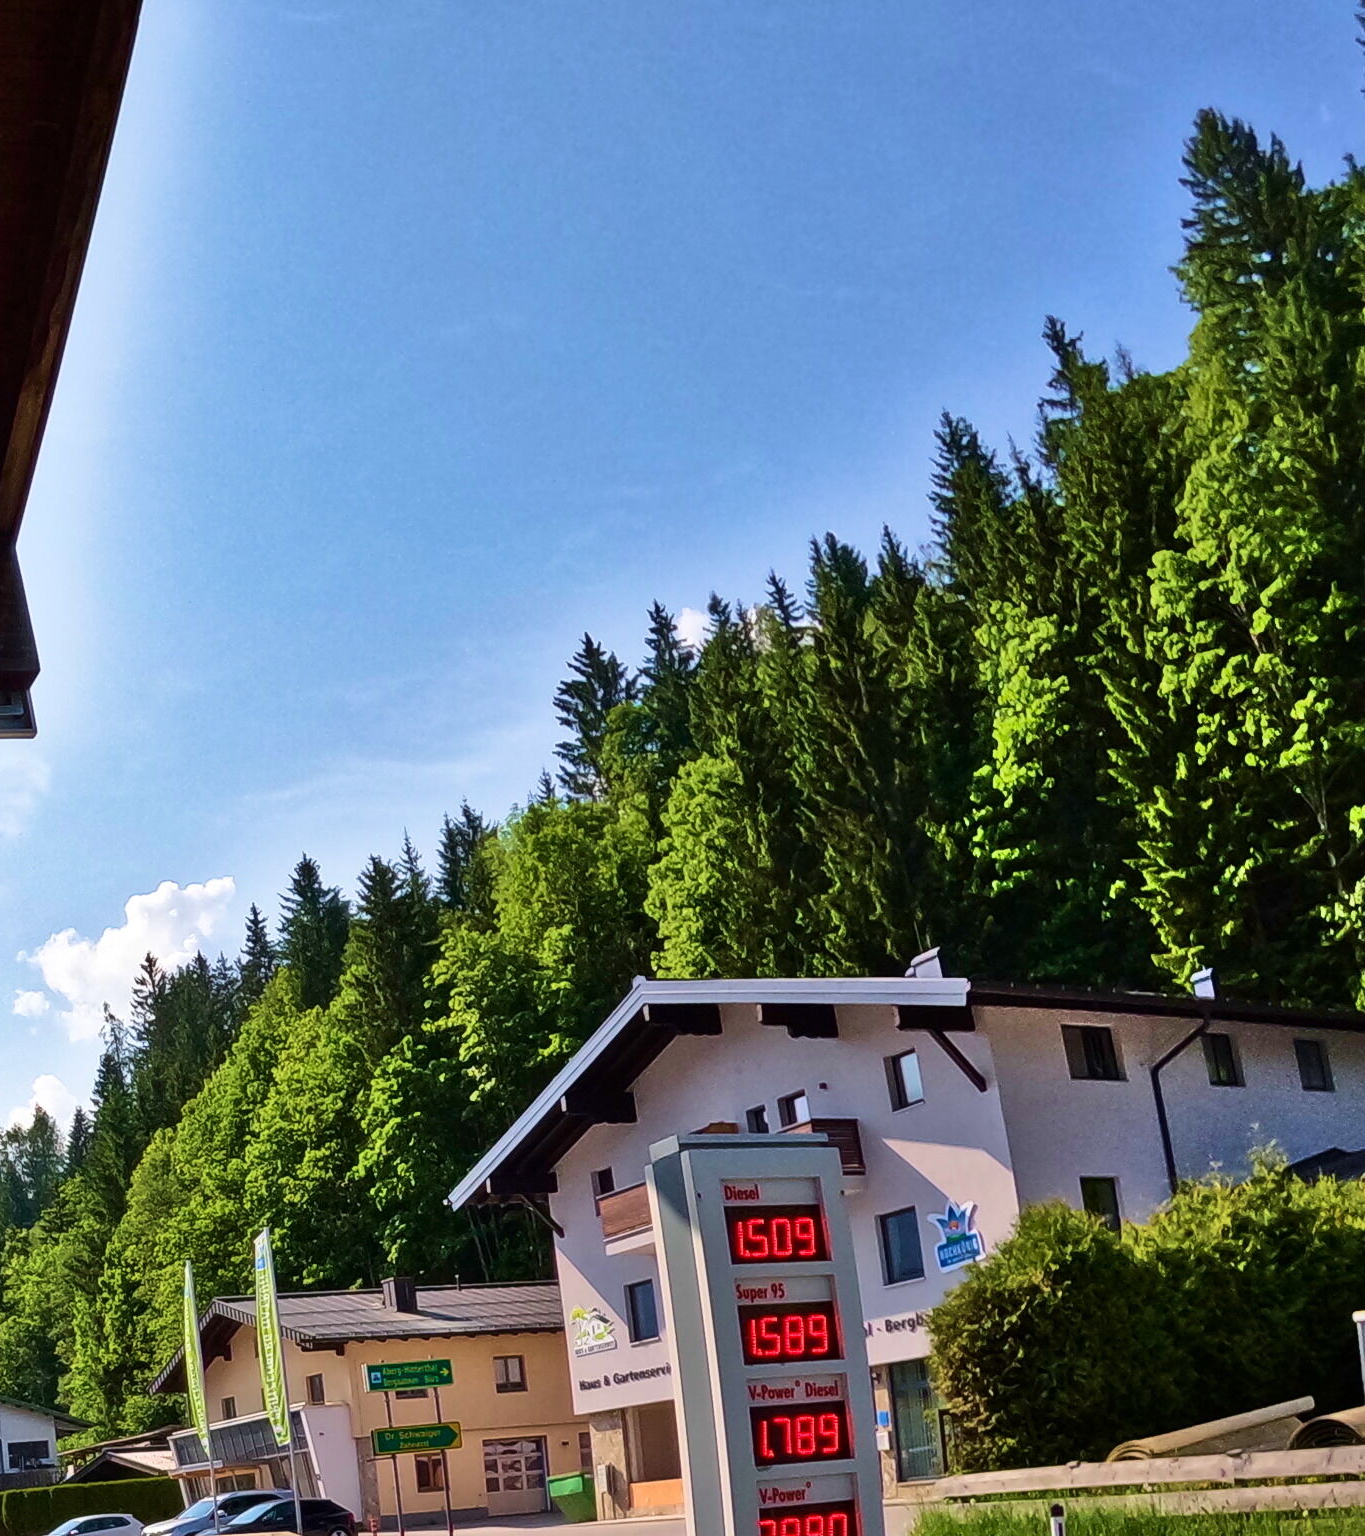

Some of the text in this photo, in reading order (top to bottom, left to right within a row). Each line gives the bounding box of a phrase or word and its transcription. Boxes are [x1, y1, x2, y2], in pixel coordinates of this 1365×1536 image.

[723, 1184, 760, 1201] Diesel
[735, 1283, 785, 1303] Super 95
[603, 1375, 611, 1387] &
[804, 1380, 839, 1398] Diesel
[399, 1429, 442, 1440] Schwaiger
